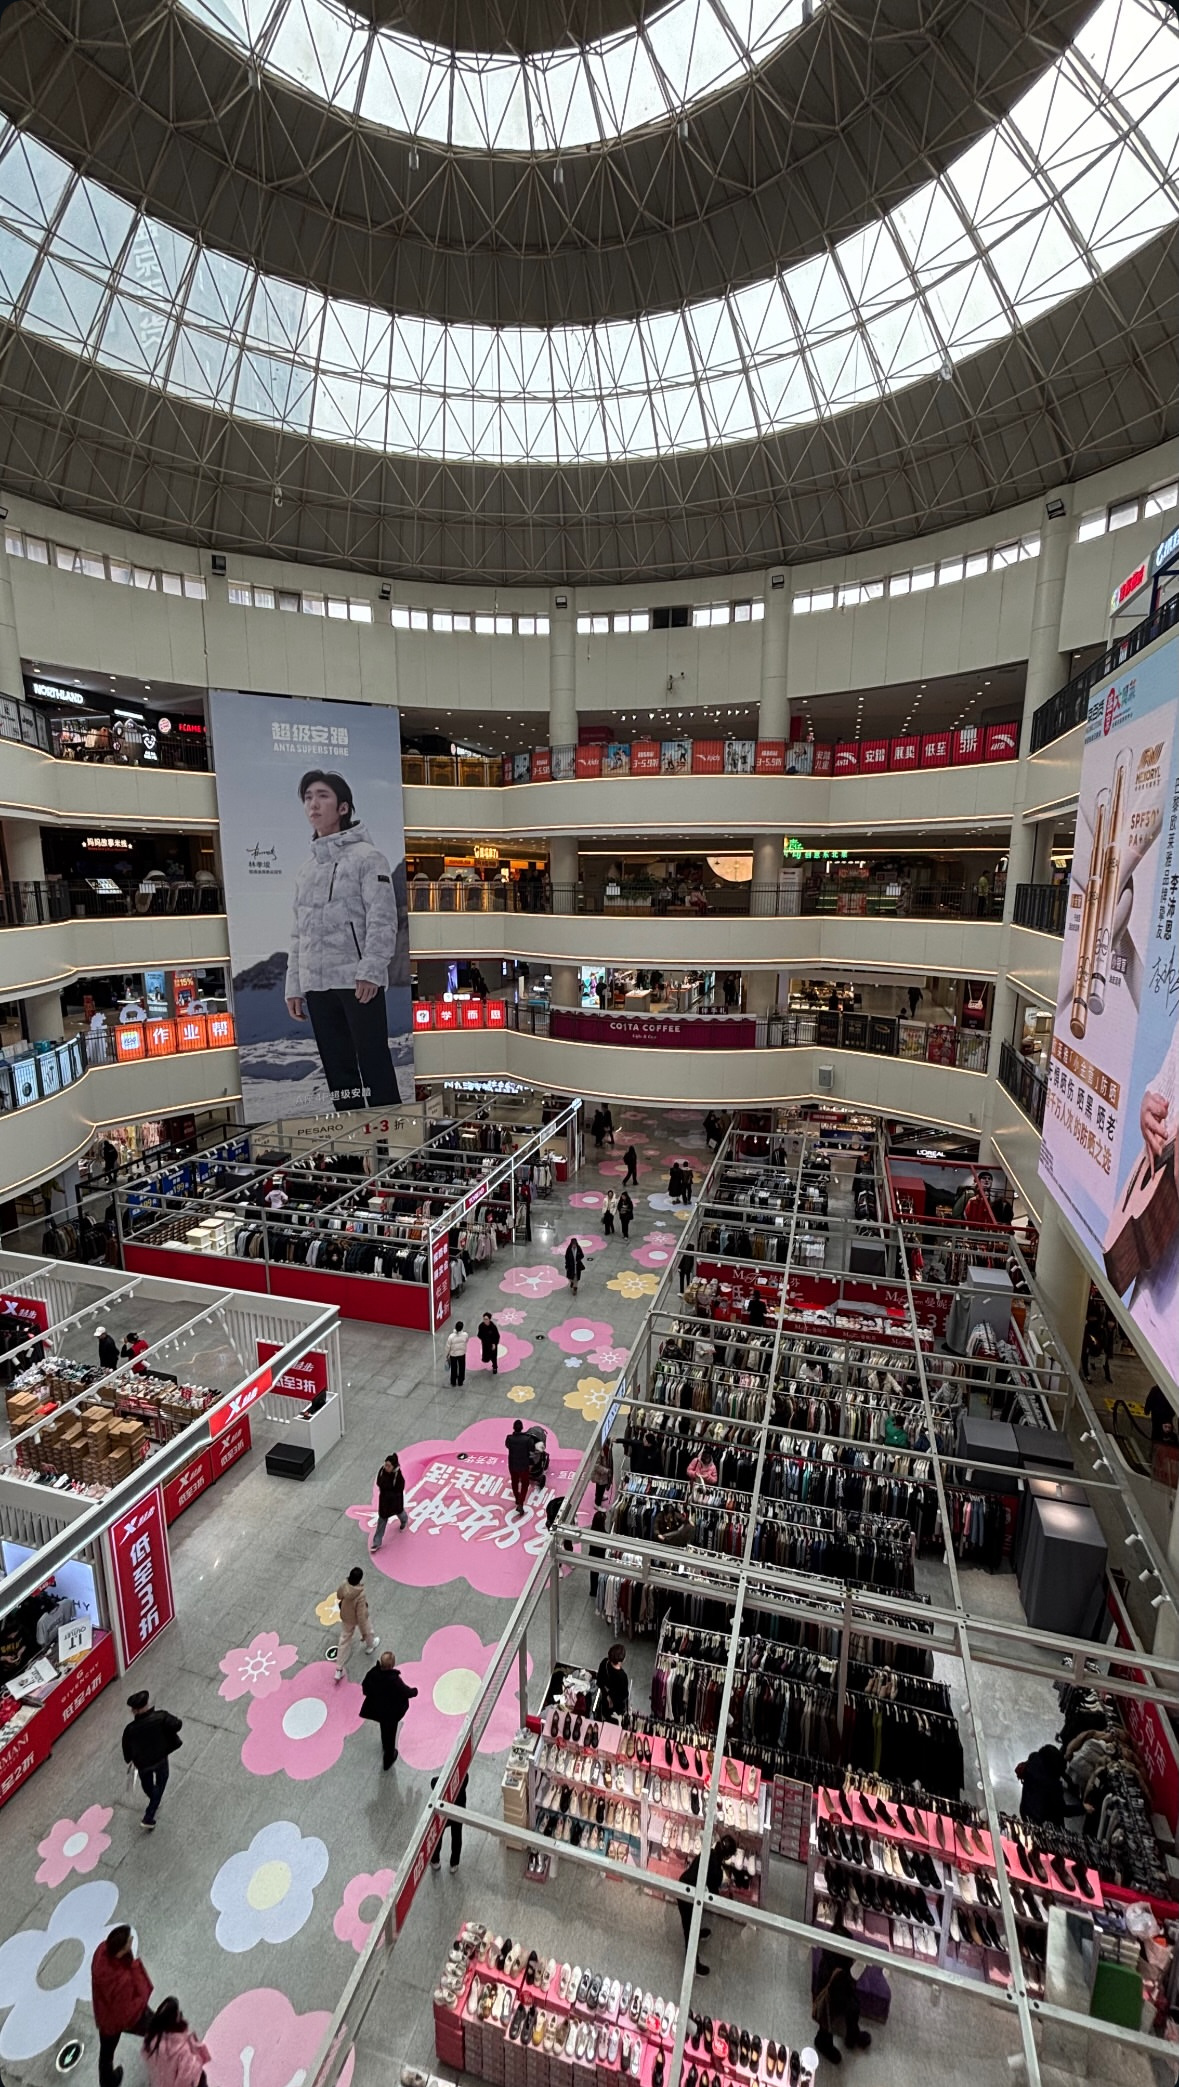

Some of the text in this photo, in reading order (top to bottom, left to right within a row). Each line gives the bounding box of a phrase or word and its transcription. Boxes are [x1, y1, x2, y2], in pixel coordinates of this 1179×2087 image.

[33, 682, 84, 704] NORTHLAND
[272, 722, 348, 745] 超级安踏
[273, 742, 349, 757] ANTA SUPERSTORE
[609, 1021, 681, 1033] COSTA COFFEE
[329, 1088, 371, 1101] 超级安踏
[297, 1123, 344, 1136] PESARO
[363, 1119, 405, 1135] 1-3 折
[1096, 1105, 1118, 1142] 晒老
[436, 1300, 450, 1320] 4折
[925, 1297, 952, 1310] 曼妮
[220, 1439, 245, 1467] 低至3折
[178, 1475, 205, 1507] 低至3折
[137, 1504, 156, 1530] 特步
[129, 1530, 161, 1642] 低至3折
[61, 1661, 99, 1703] GIVENCHY
[62, 1673, 102, 1722] 低至4折
